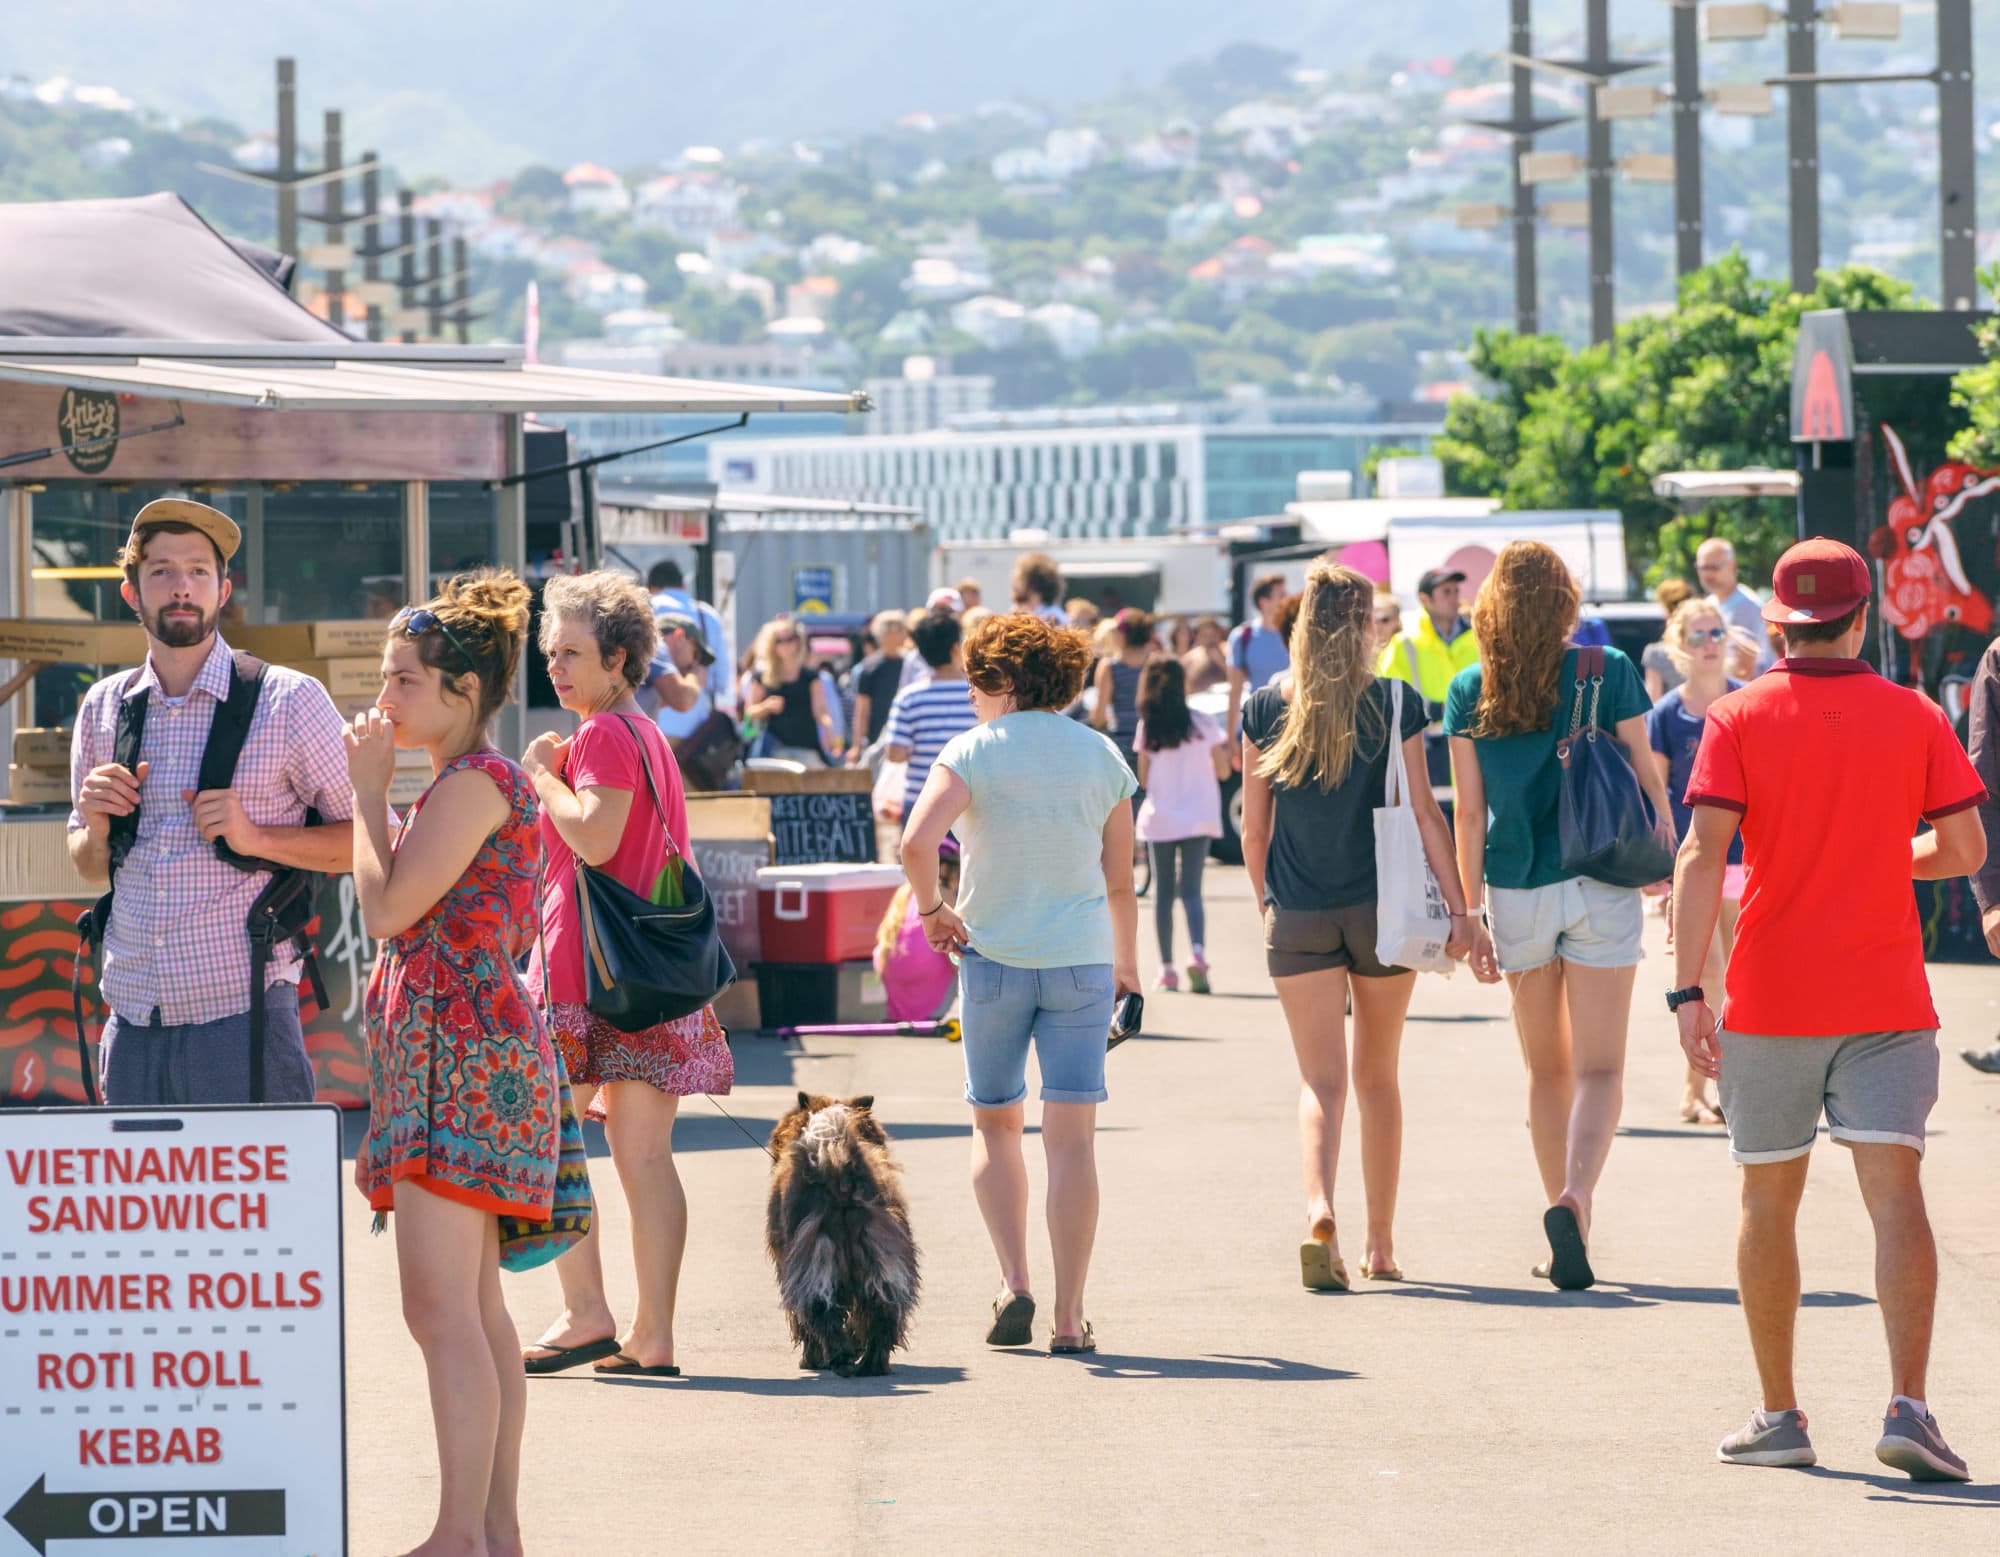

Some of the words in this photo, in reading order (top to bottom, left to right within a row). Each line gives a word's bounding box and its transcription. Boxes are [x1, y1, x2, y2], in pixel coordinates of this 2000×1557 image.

[808, 794, 857, 819] COAST
[6, 1145, 288, 1185] VIETNAMESE
[27, 1193, 268, 1233] SANDWICH
[0, 1274, 172, 1313] UMMER
[188, 1271, 322, 1310] ROLLS
[37, 1352, 135, 1390] ROTI
[152, 1350, 262, 1388] ROLL
[79, 1427, 222, 1465] KEBAB
[88, 1497, 227, 1534] OPEN
